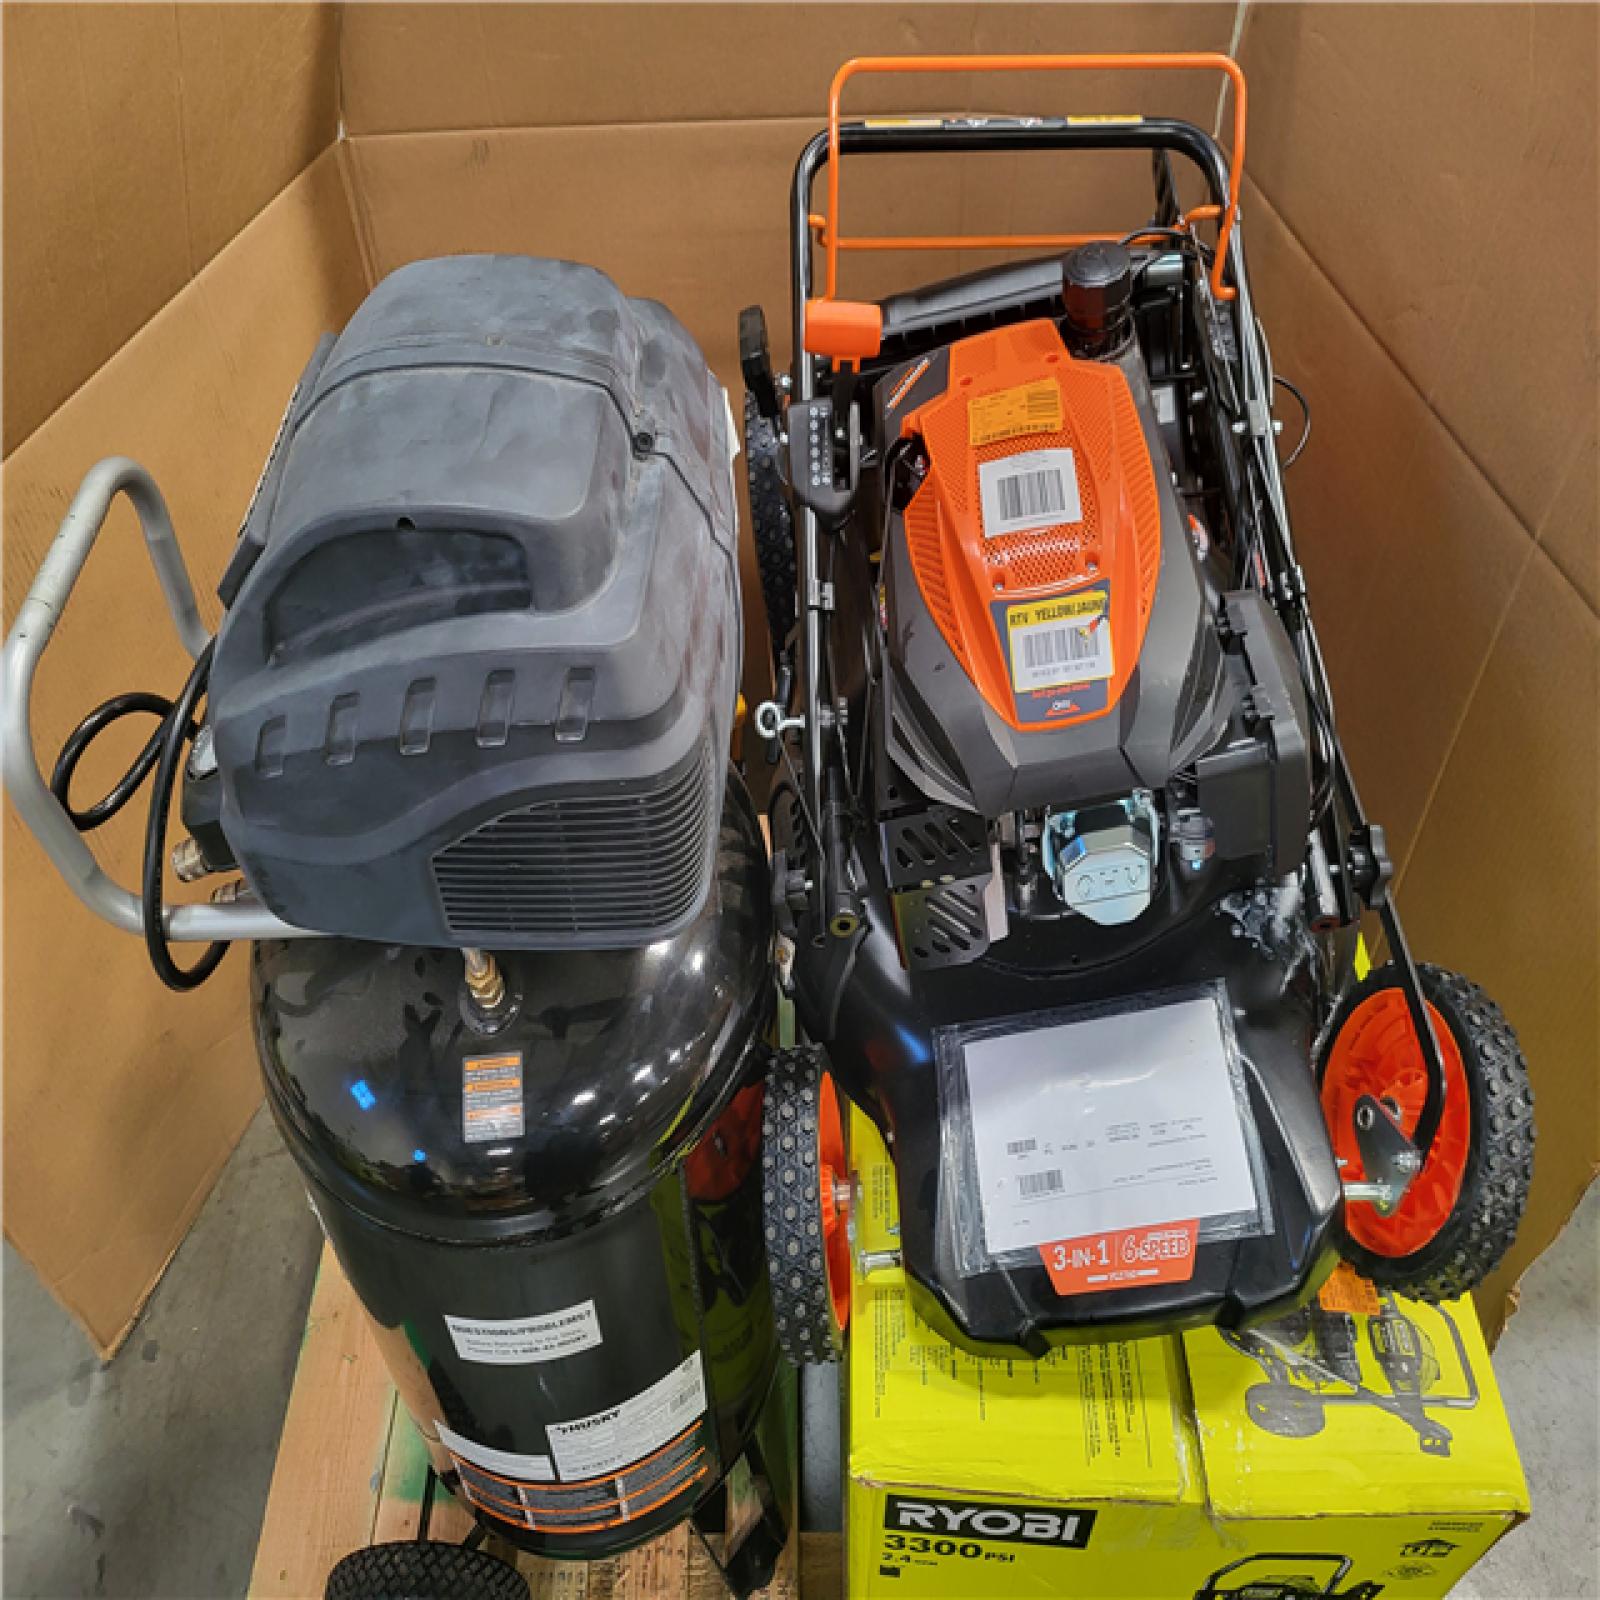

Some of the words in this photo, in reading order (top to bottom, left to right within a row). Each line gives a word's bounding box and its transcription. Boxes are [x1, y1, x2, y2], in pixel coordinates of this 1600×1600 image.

[1053, 1239, 1111, 1271] 3-IN-1
[896, 1502, 1081, 1541] RYOBI
[884, 1534, 984, 1559] 3300
[984, 1551, 1016, 1564] PSI
